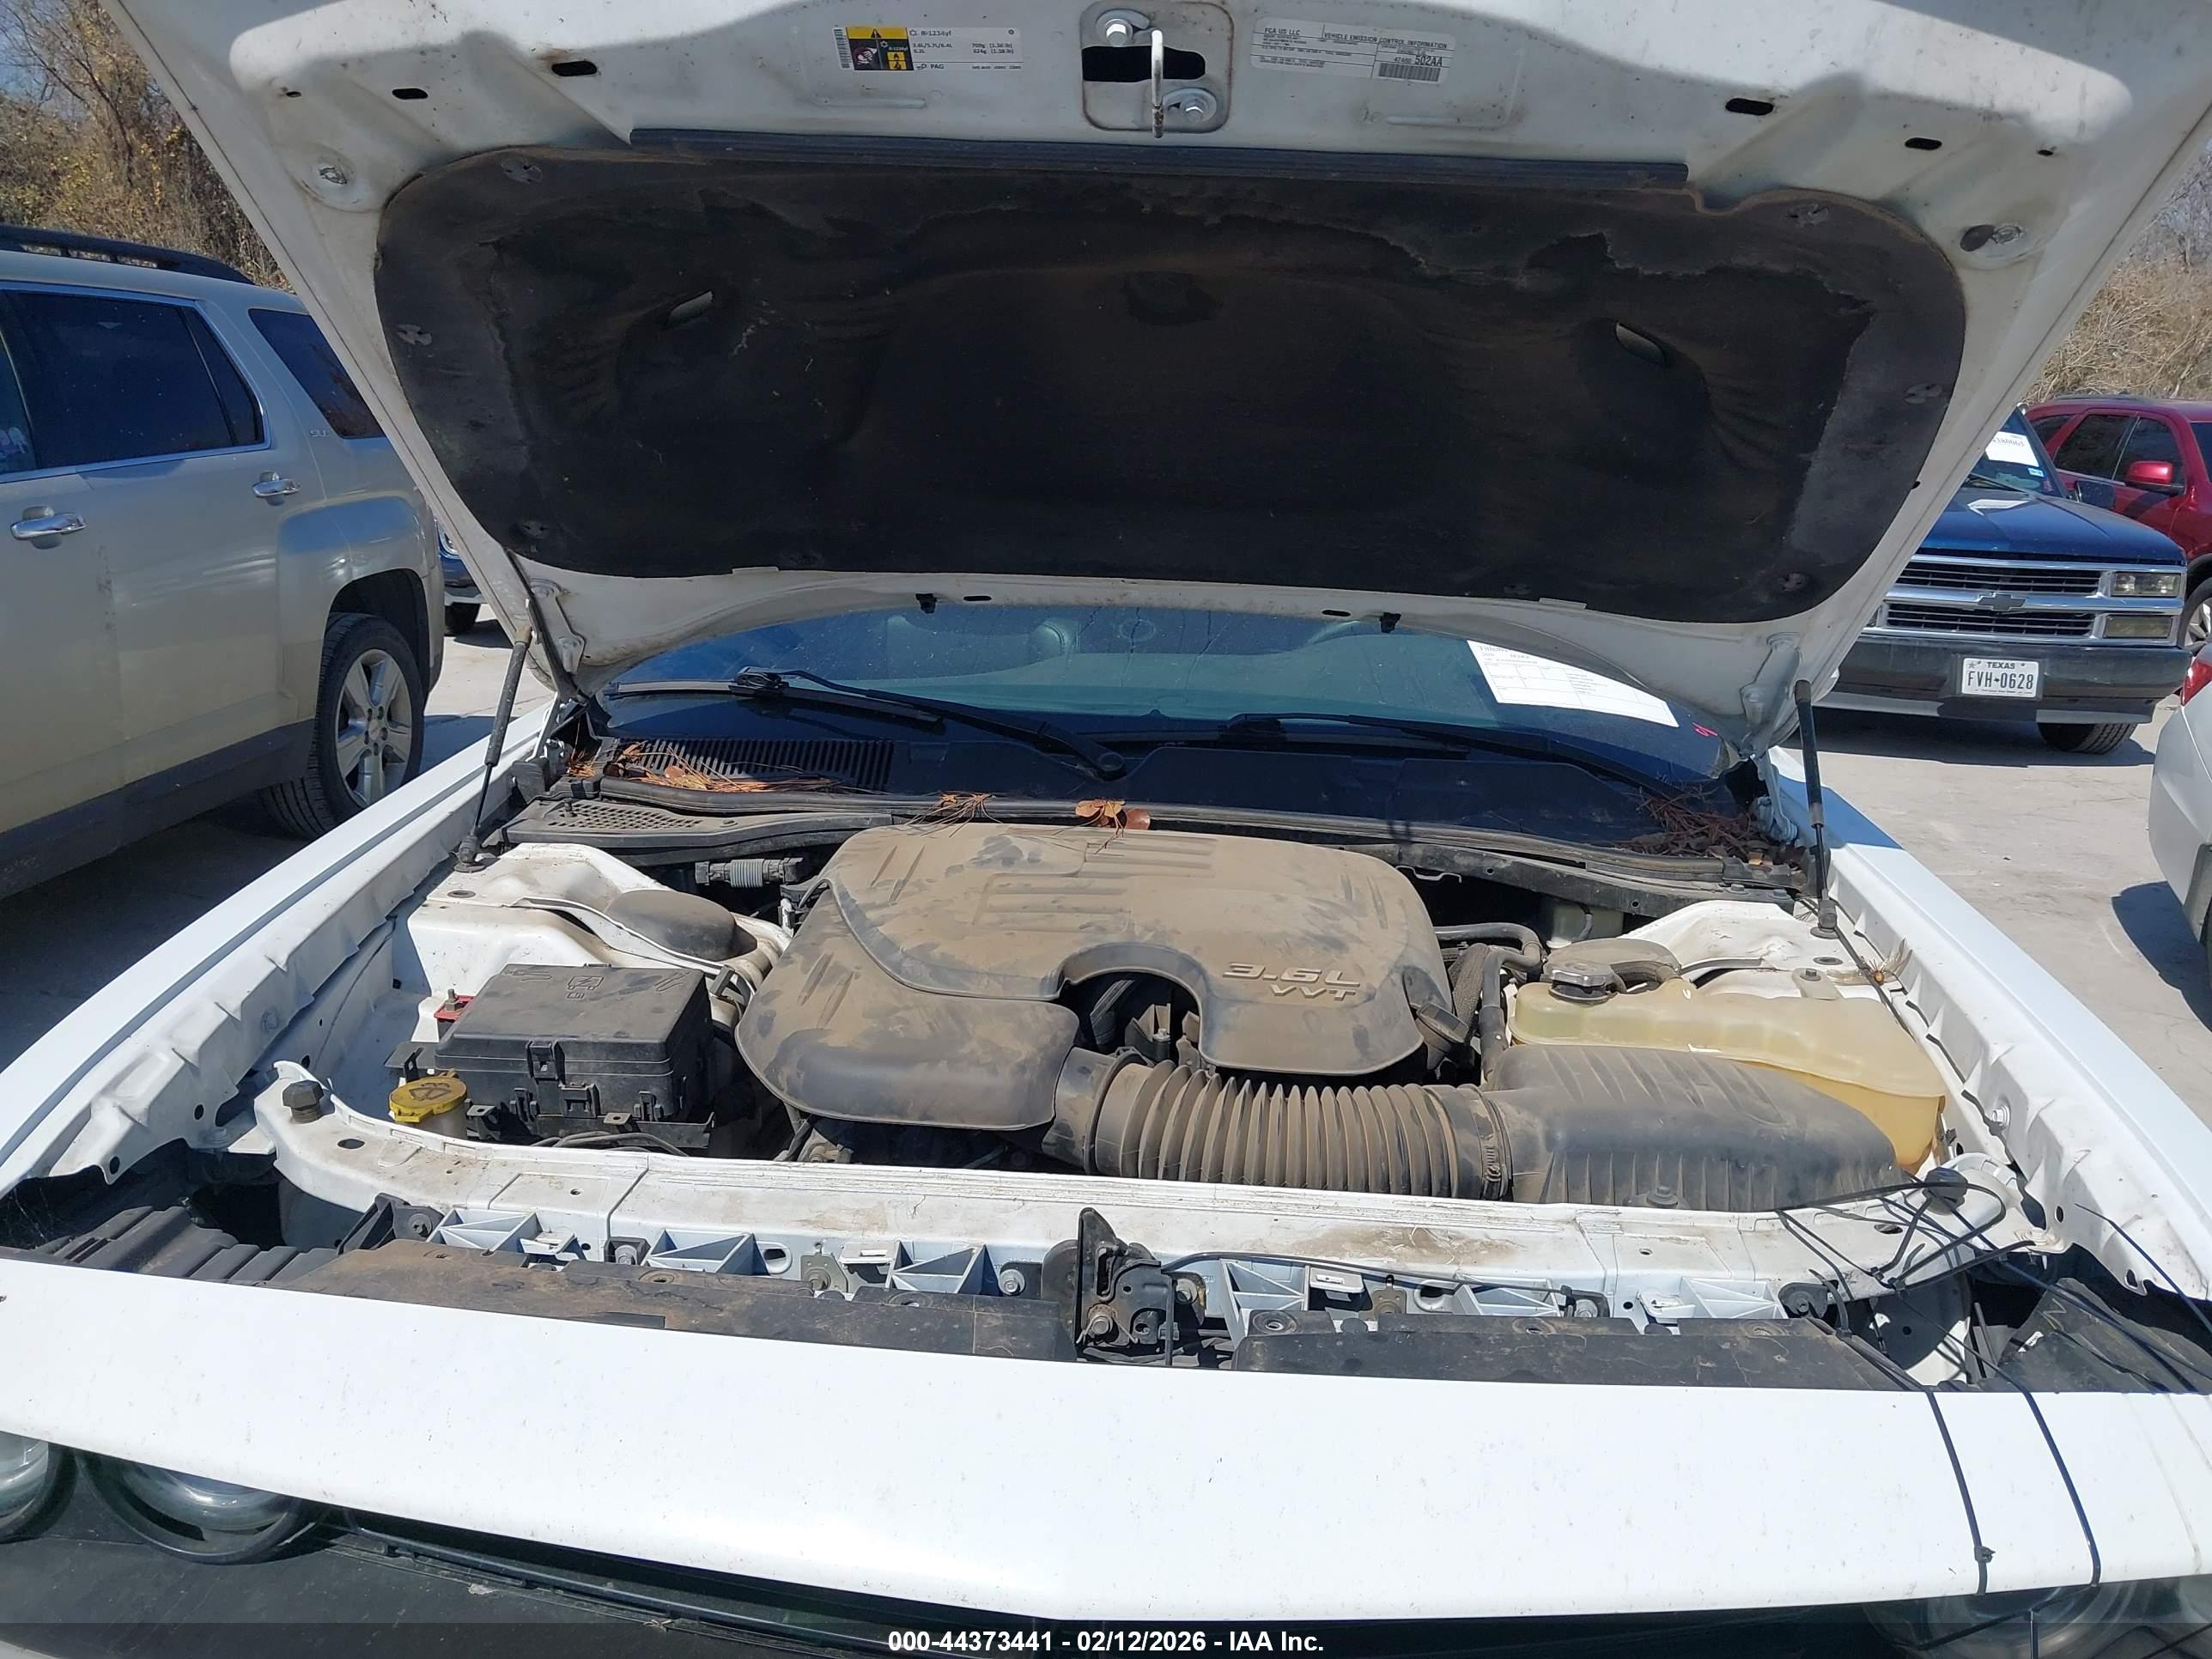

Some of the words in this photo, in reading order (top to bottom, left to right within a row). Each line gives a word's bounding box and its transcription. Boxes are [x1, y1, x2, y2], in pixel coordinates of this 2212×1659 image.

[1407, 40, 1448, 49] INFORMATION
[1415, 55, 1443, 66] 502AA
[1223, 962, 1360, 988] 3.6L
[1270, 984, 1356, 1001] VVT
